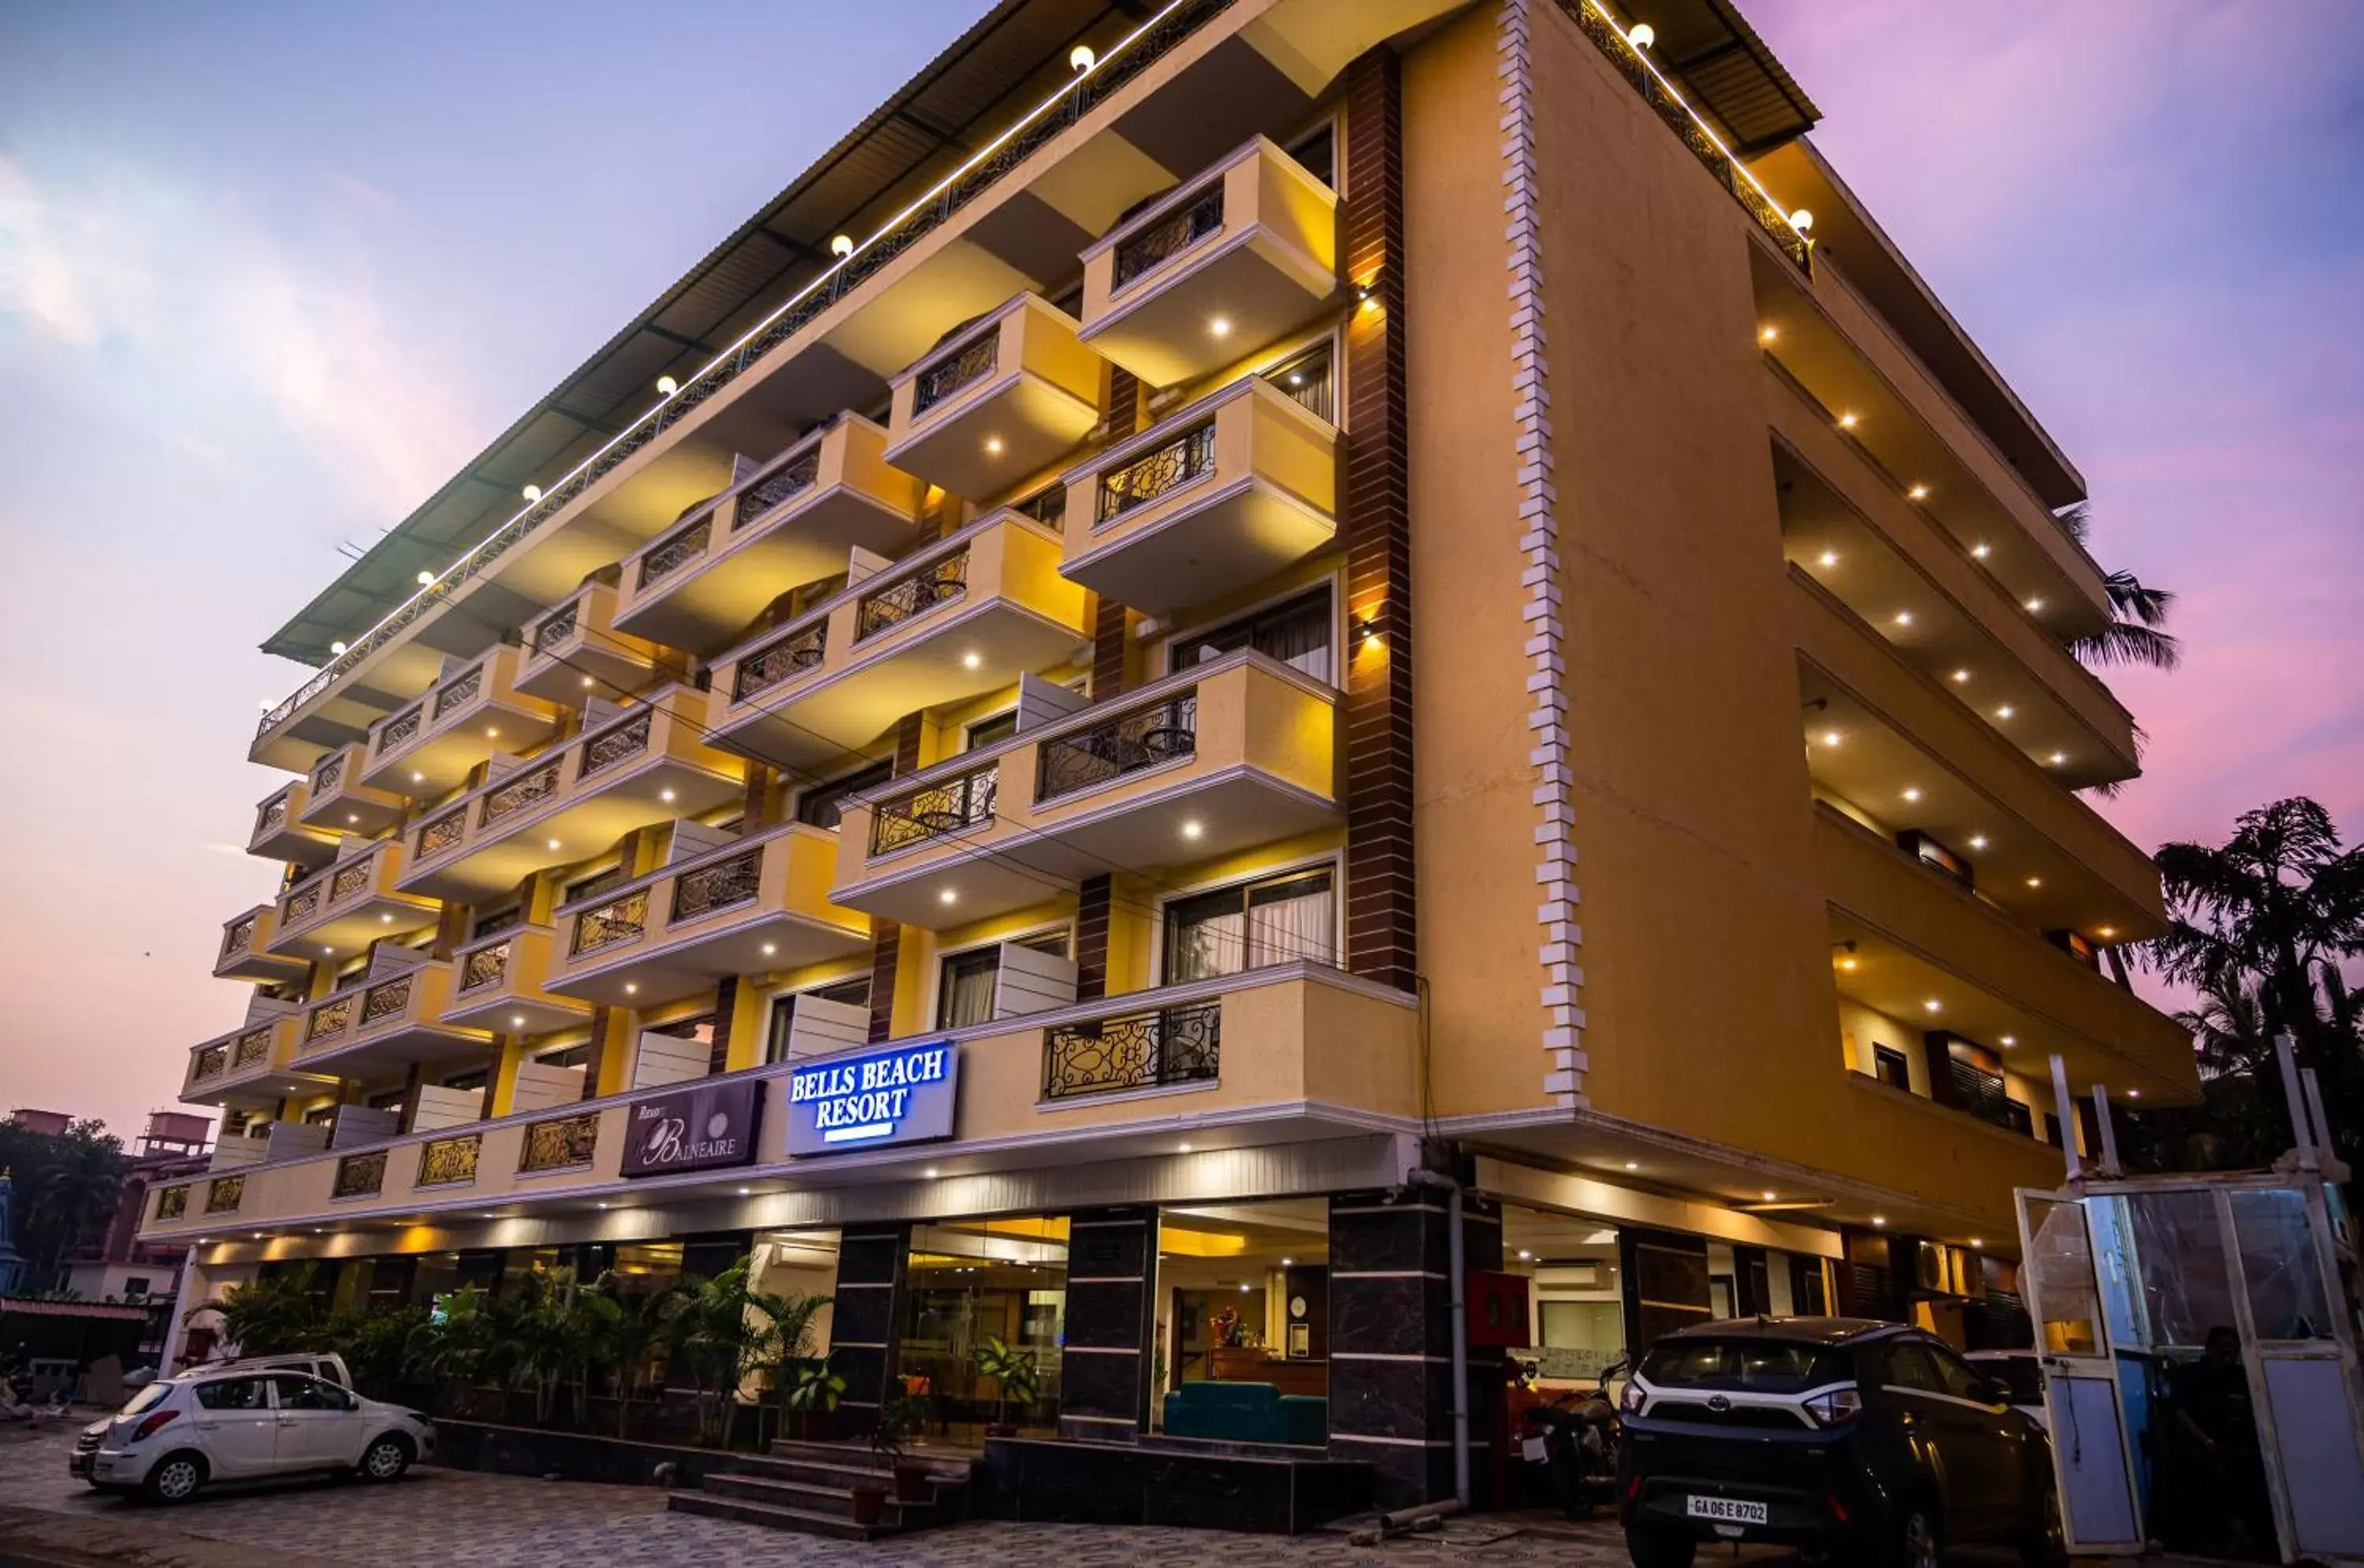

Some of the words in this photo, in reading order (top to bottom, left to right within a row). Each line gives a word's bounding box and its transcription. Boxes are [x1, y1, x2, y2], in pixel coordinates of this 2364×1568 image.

[790, 1066, 856, 1102] BELLS
[861, 1050, 943, 1091] BEACH
[815, 1088, 907, 1128] RESORT
[1695, 1499, 1708, 1514] GA
[1711, 1501, 1725, 1516] 06
[1735, 1503, 1764, 1520] 8702
